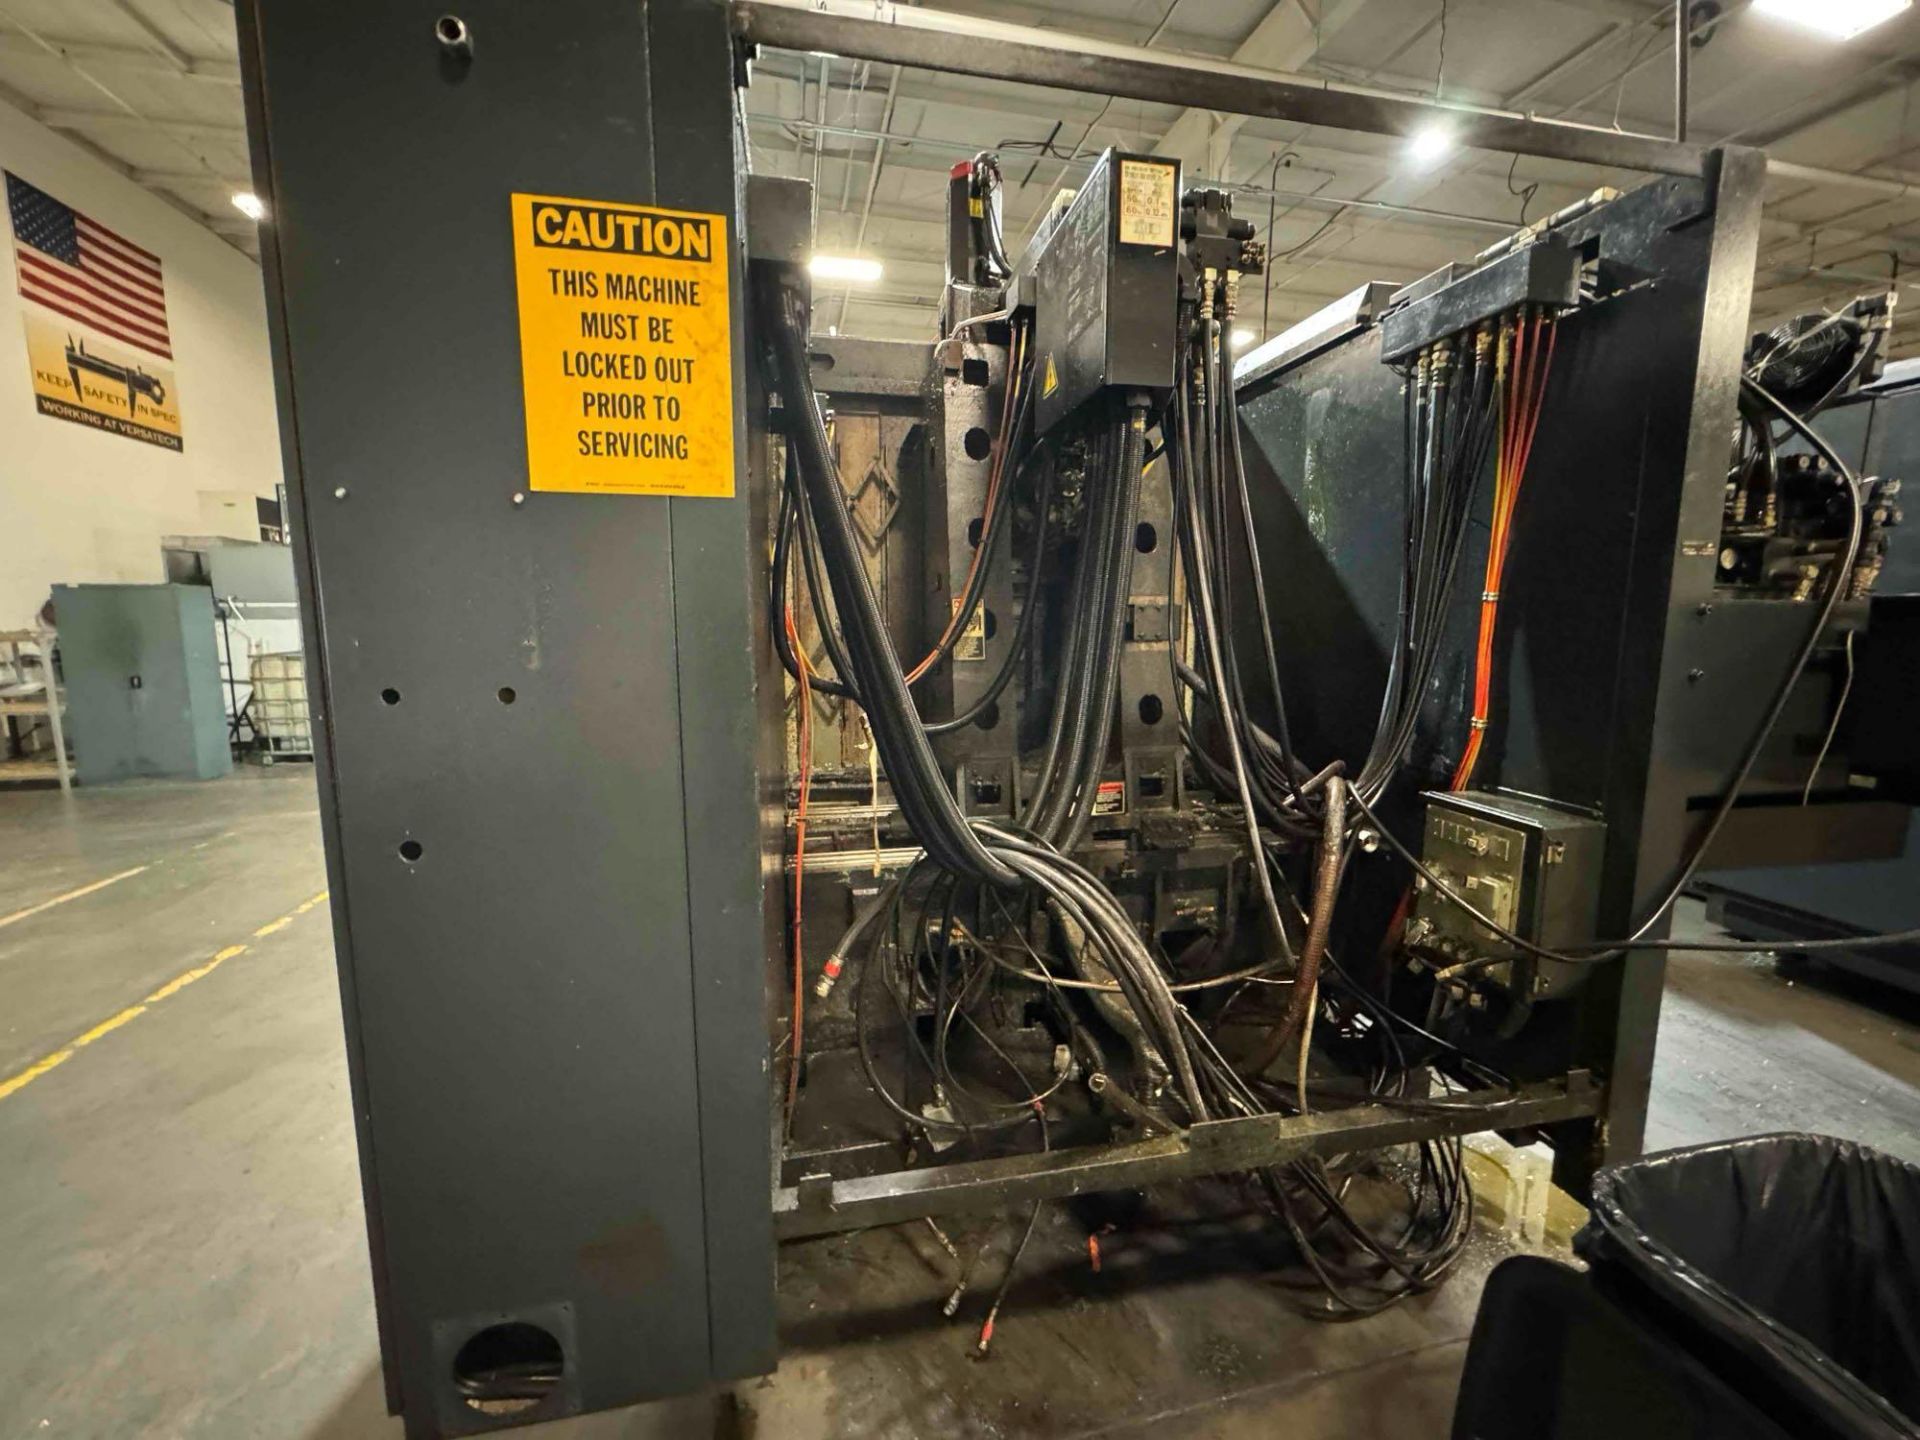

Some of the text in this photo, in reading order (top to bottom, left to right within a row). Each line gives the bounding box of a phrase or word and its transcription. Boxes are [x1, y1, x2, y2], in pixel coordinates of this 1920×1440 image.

[535, 207, 709, 258] CAUTION
[548, 268, 701, 307] THIS MACHINE
[581, 311, 674, 343] MUST BE
[562, 350, 695, 384] LOCKED OUT
[36, 369, 176, 424] KEEP SAFETY IN SPEC
[582, 391, 681, 422] PRIOR TO
[41, 399, 178, 448] WORKING AT VERSATECH
[577, 429, 689, 460] SERVICING
